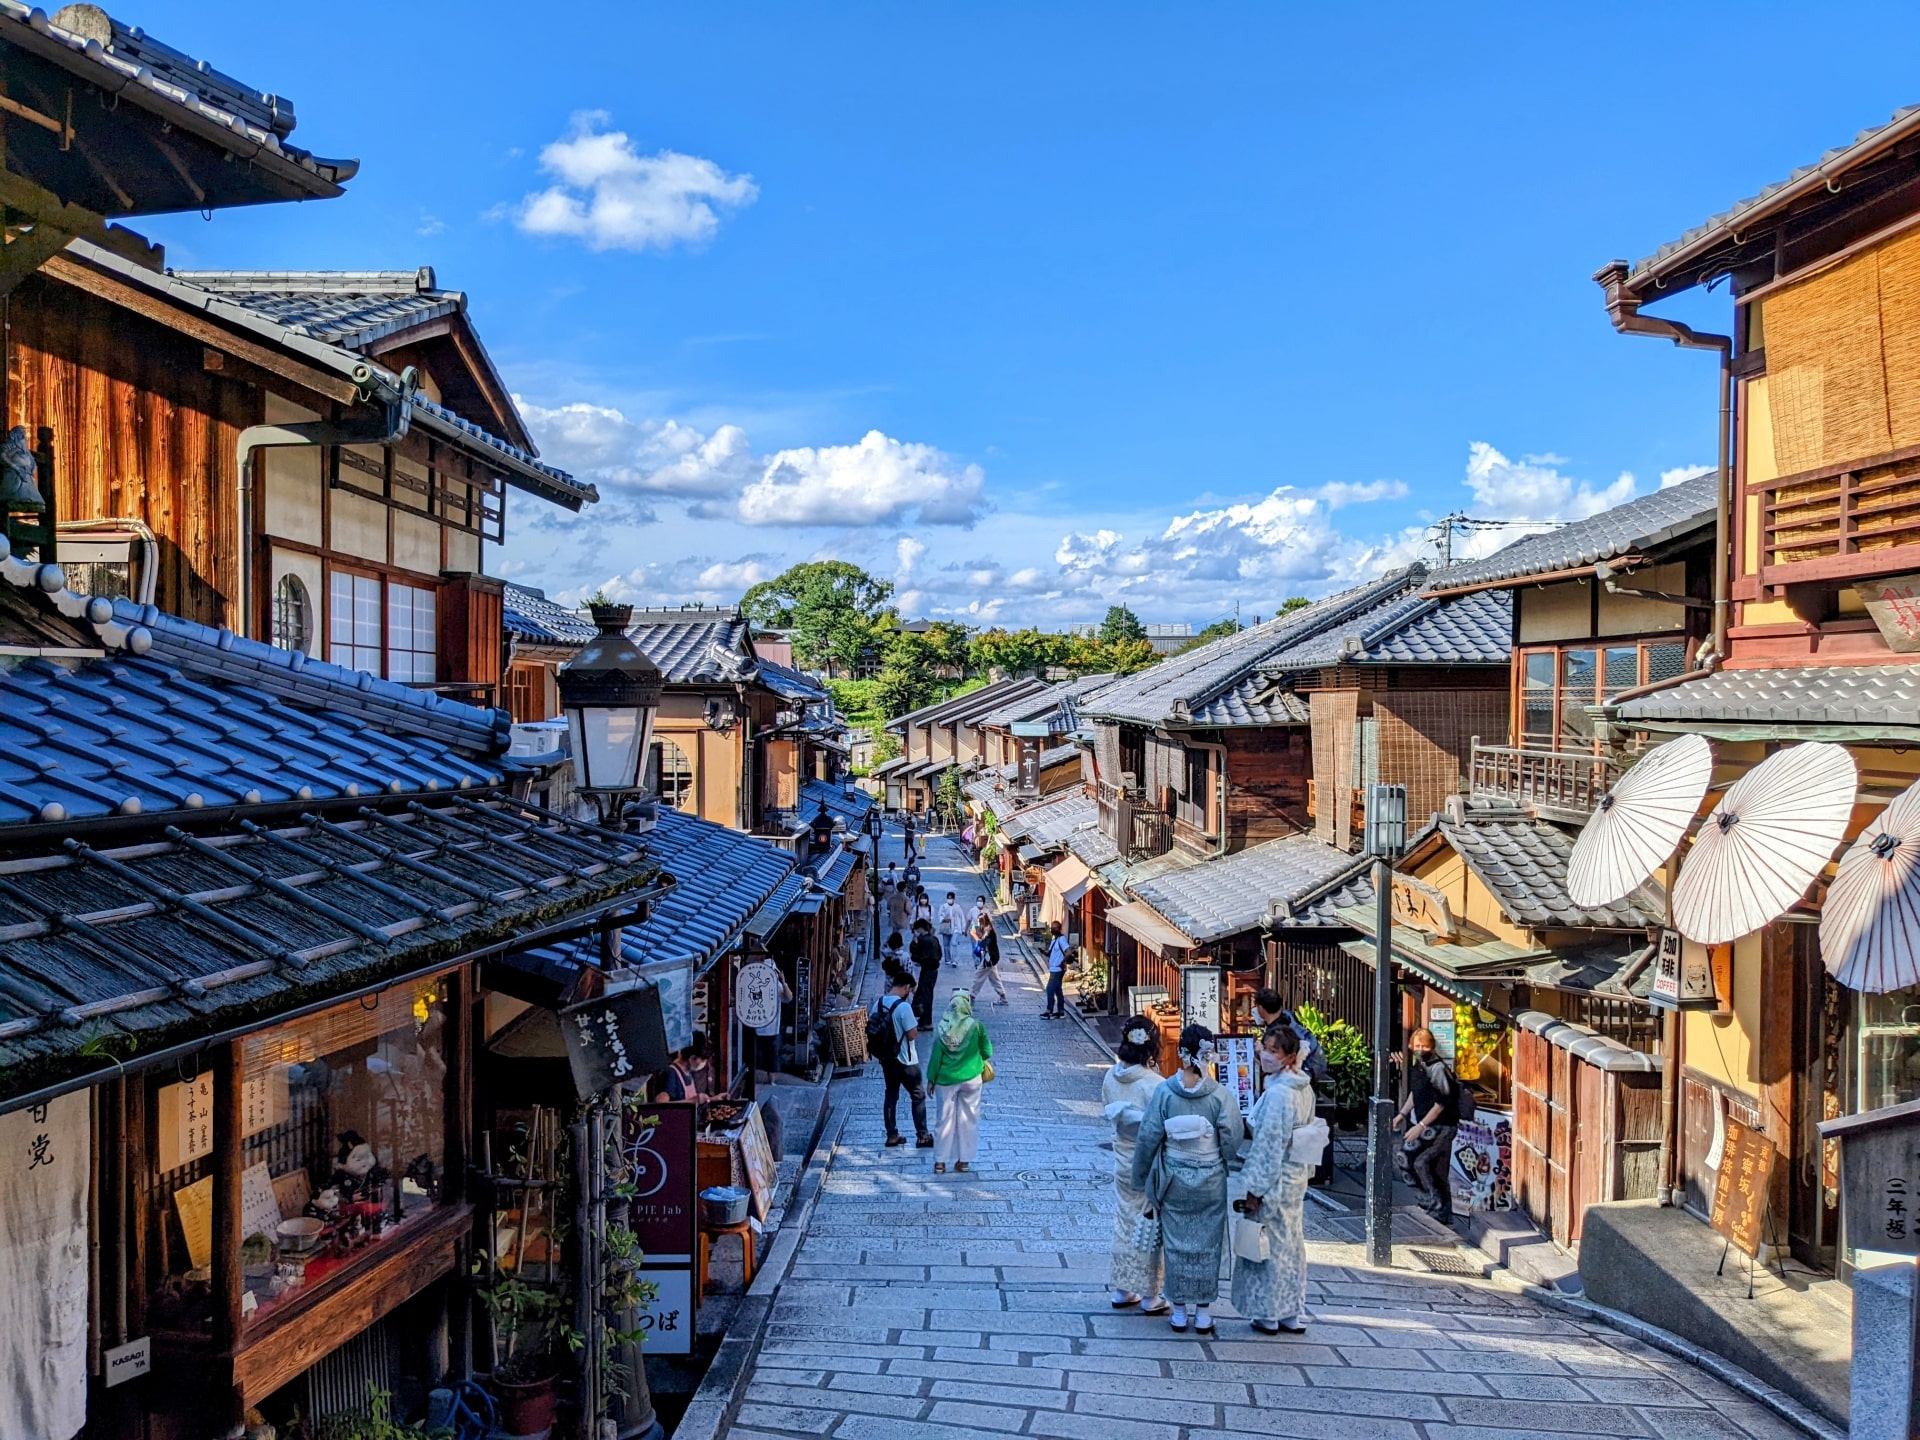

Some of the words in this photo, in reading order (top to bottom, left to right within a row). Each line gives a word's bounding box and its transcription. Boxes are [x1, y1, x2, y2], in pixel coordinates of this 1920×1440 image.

[1661, 935, 1677, 977] 珈琲
[1208, 976, 1217, 1003] そば処
[1656, 978, 1677, 993] COFFEE
[1738, 1142, 1756, 1196] 二寧坂
[1757, 1145, 1771, 1173] 京都
[1712, 1124, 1739, 1225] 珈琲焙煎工房
[637, 1205, 657, 1215] PIE
[662, 1205, 682, 1215] lab
[1731, 1220, 1749, 1239] Coffee
[134, 1360, 145, 1368] YA
